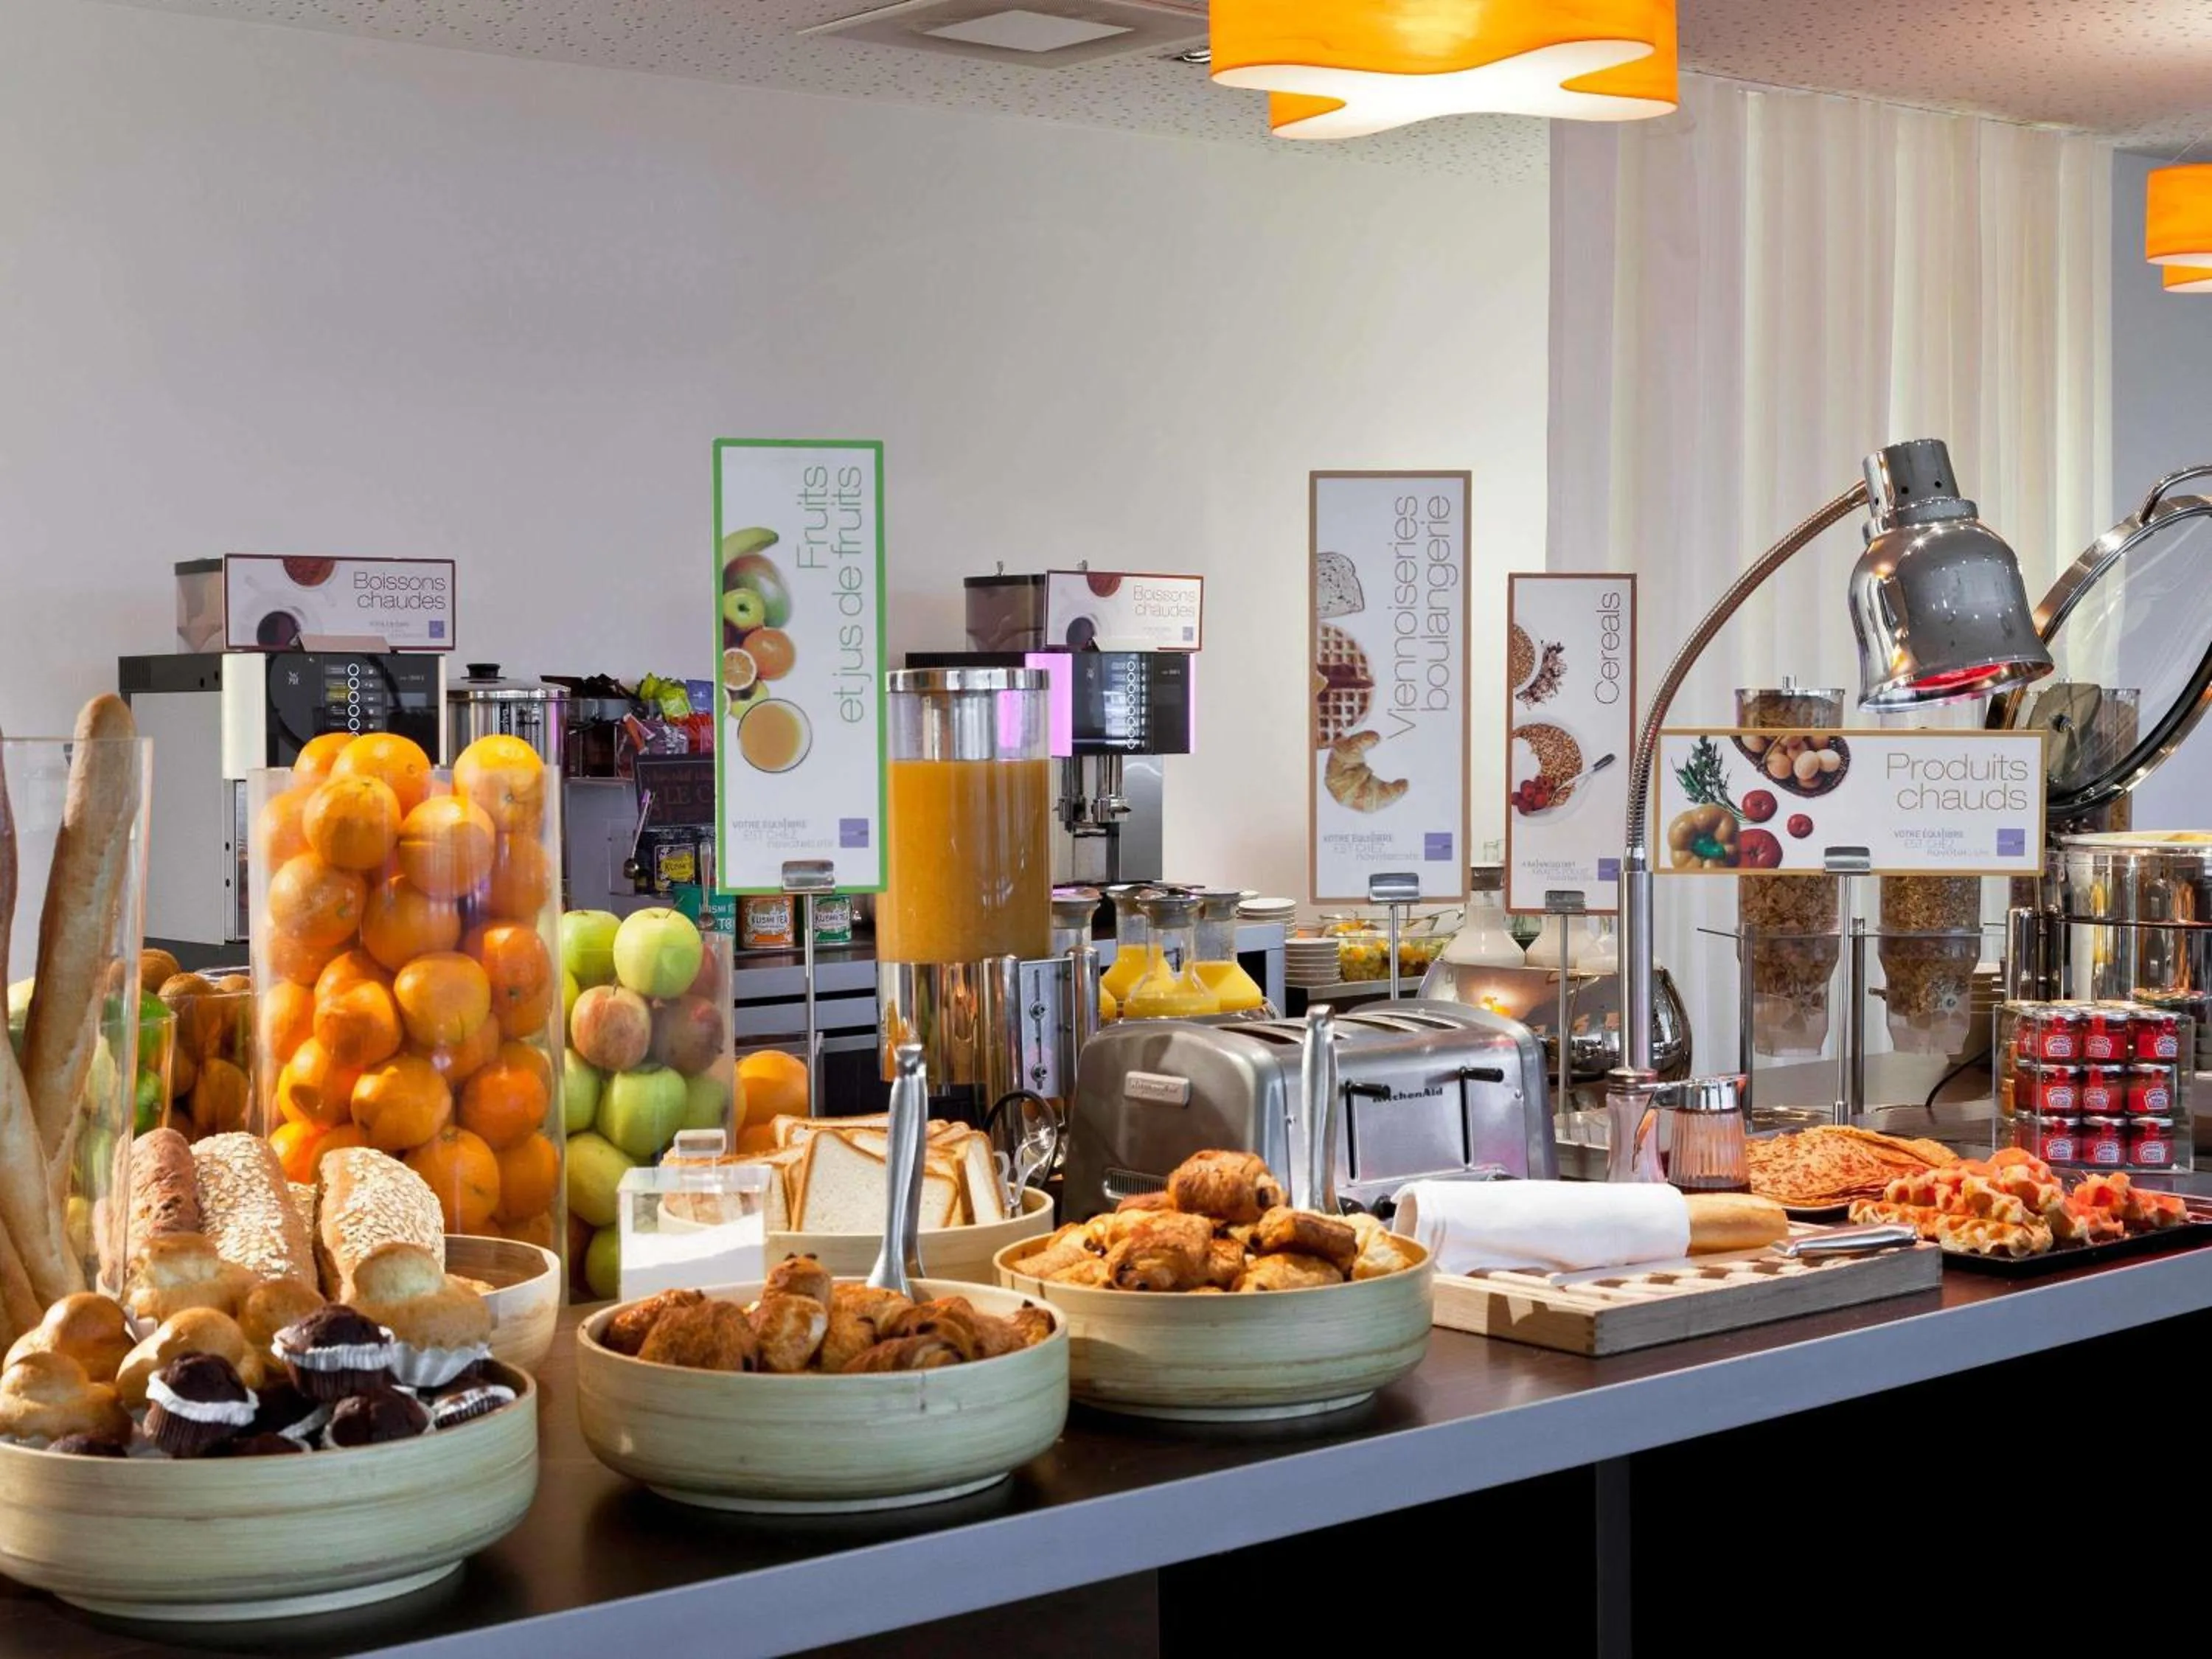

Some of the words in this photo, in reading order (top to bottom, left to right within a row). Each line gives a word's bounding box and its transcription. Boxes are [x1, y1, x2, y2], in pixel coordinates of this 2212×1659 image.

[796, 466, 828, 568] Fruits
[830, 466, 862, 559] fruits
[353, 571, 445, 591] Boissons
[357, 591, 445, 610] chaudes
[831, 566, 863, 616] de
[1133, 585, 1195, 602] Boissons
[1135, 602, 1195, 618] chaudes
[1387, 495, 1418, 739] Viennoiseries
[1419, 495, 1458, 712] boulangerie
[832, 625, 872, 683] jus
[1595, 592, 1621, 704] Cereals
[832, 686, 864, 723] et
[1887, 753, 2028, 781] Produits
[1897, 783, 2028, 810] chauds
